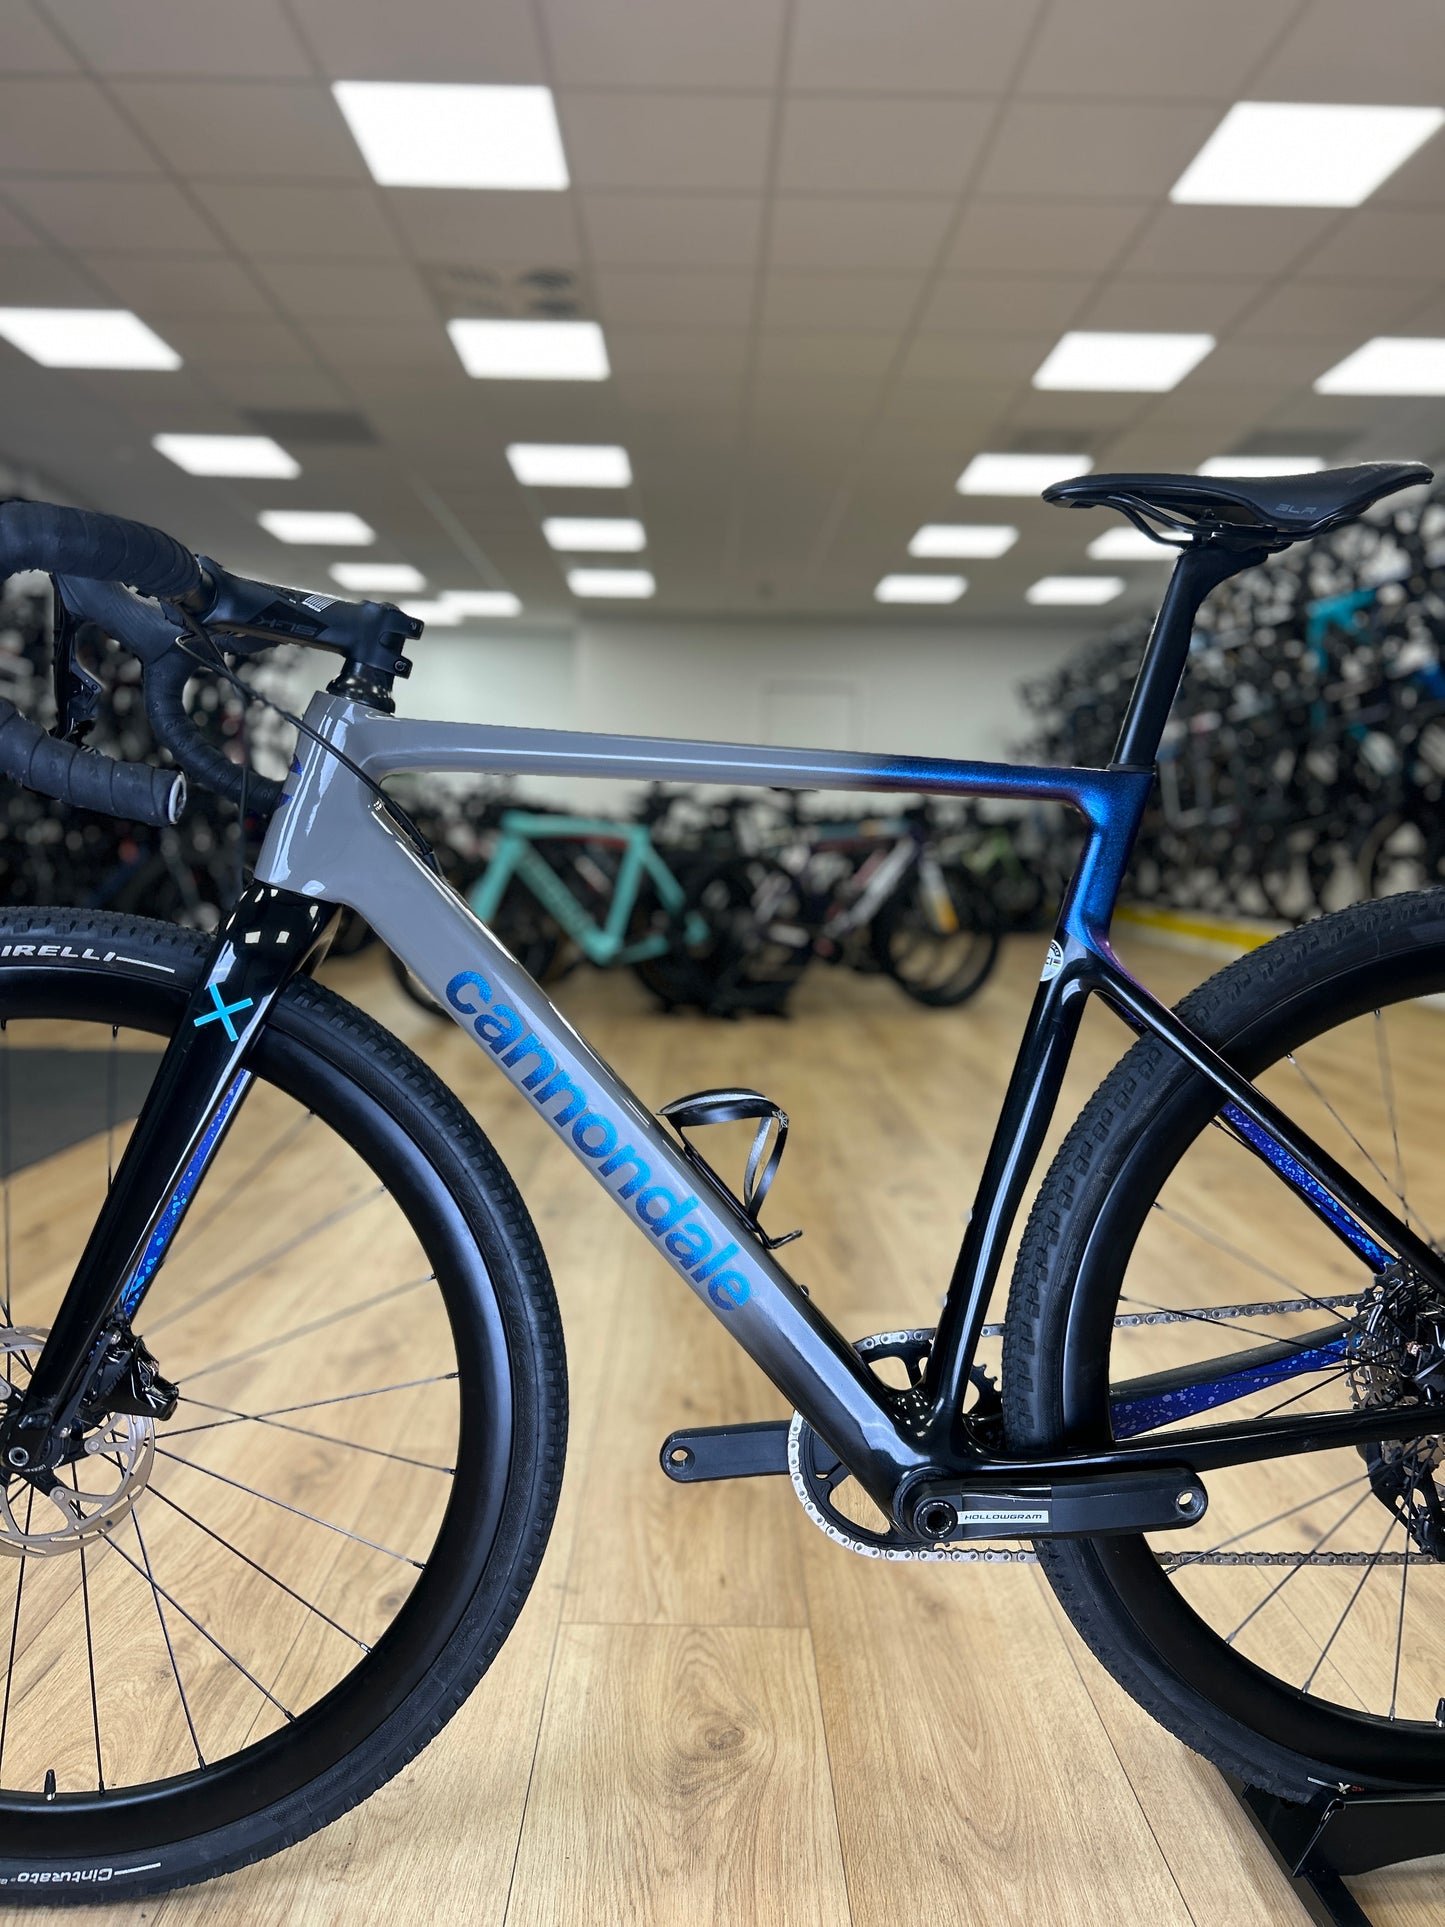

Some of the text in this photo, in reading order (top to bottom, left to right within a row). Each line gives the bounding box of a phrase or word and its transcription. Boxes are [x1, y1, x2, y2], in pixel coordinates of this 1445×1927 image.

[1275, 503, 1317, 514] SLR
[0, 945, 116, 962] IRELLI
[445, 970, 752, 1311] cannondale
[17, 1867, 113, 1884] Cinturato
